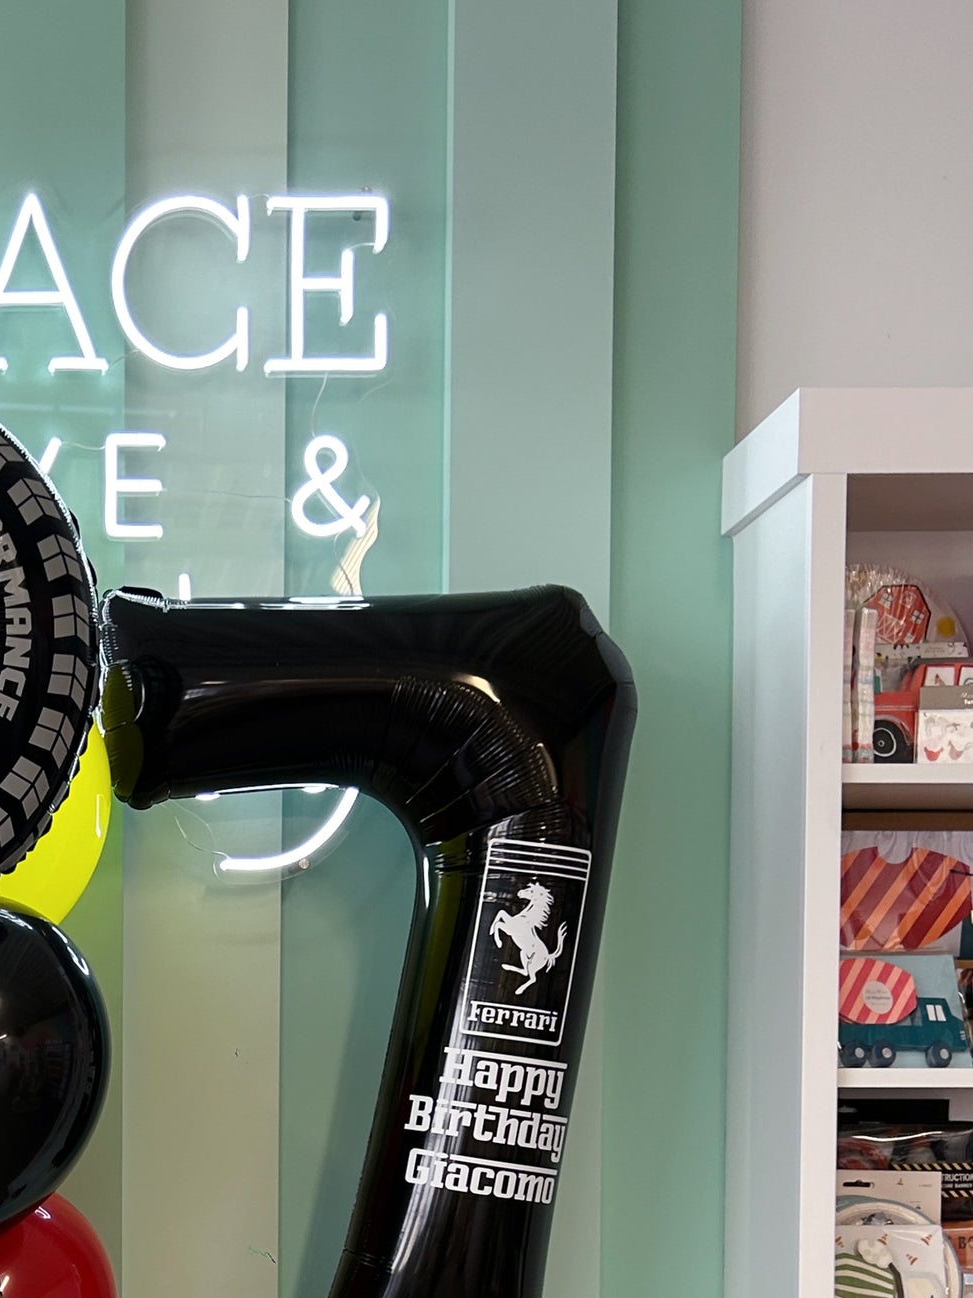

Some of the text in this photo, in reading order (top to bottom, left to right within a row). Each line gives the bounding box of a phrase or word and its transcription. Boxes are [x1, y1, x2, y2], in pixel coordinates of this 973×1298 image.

[467, 1001, 559, 1033] Ferrari
[438, 1047, 568, 1110] Happy
[403, 1094, 568, 1163] Birthday
[404, 1147, 558, 1206] Giacomo
